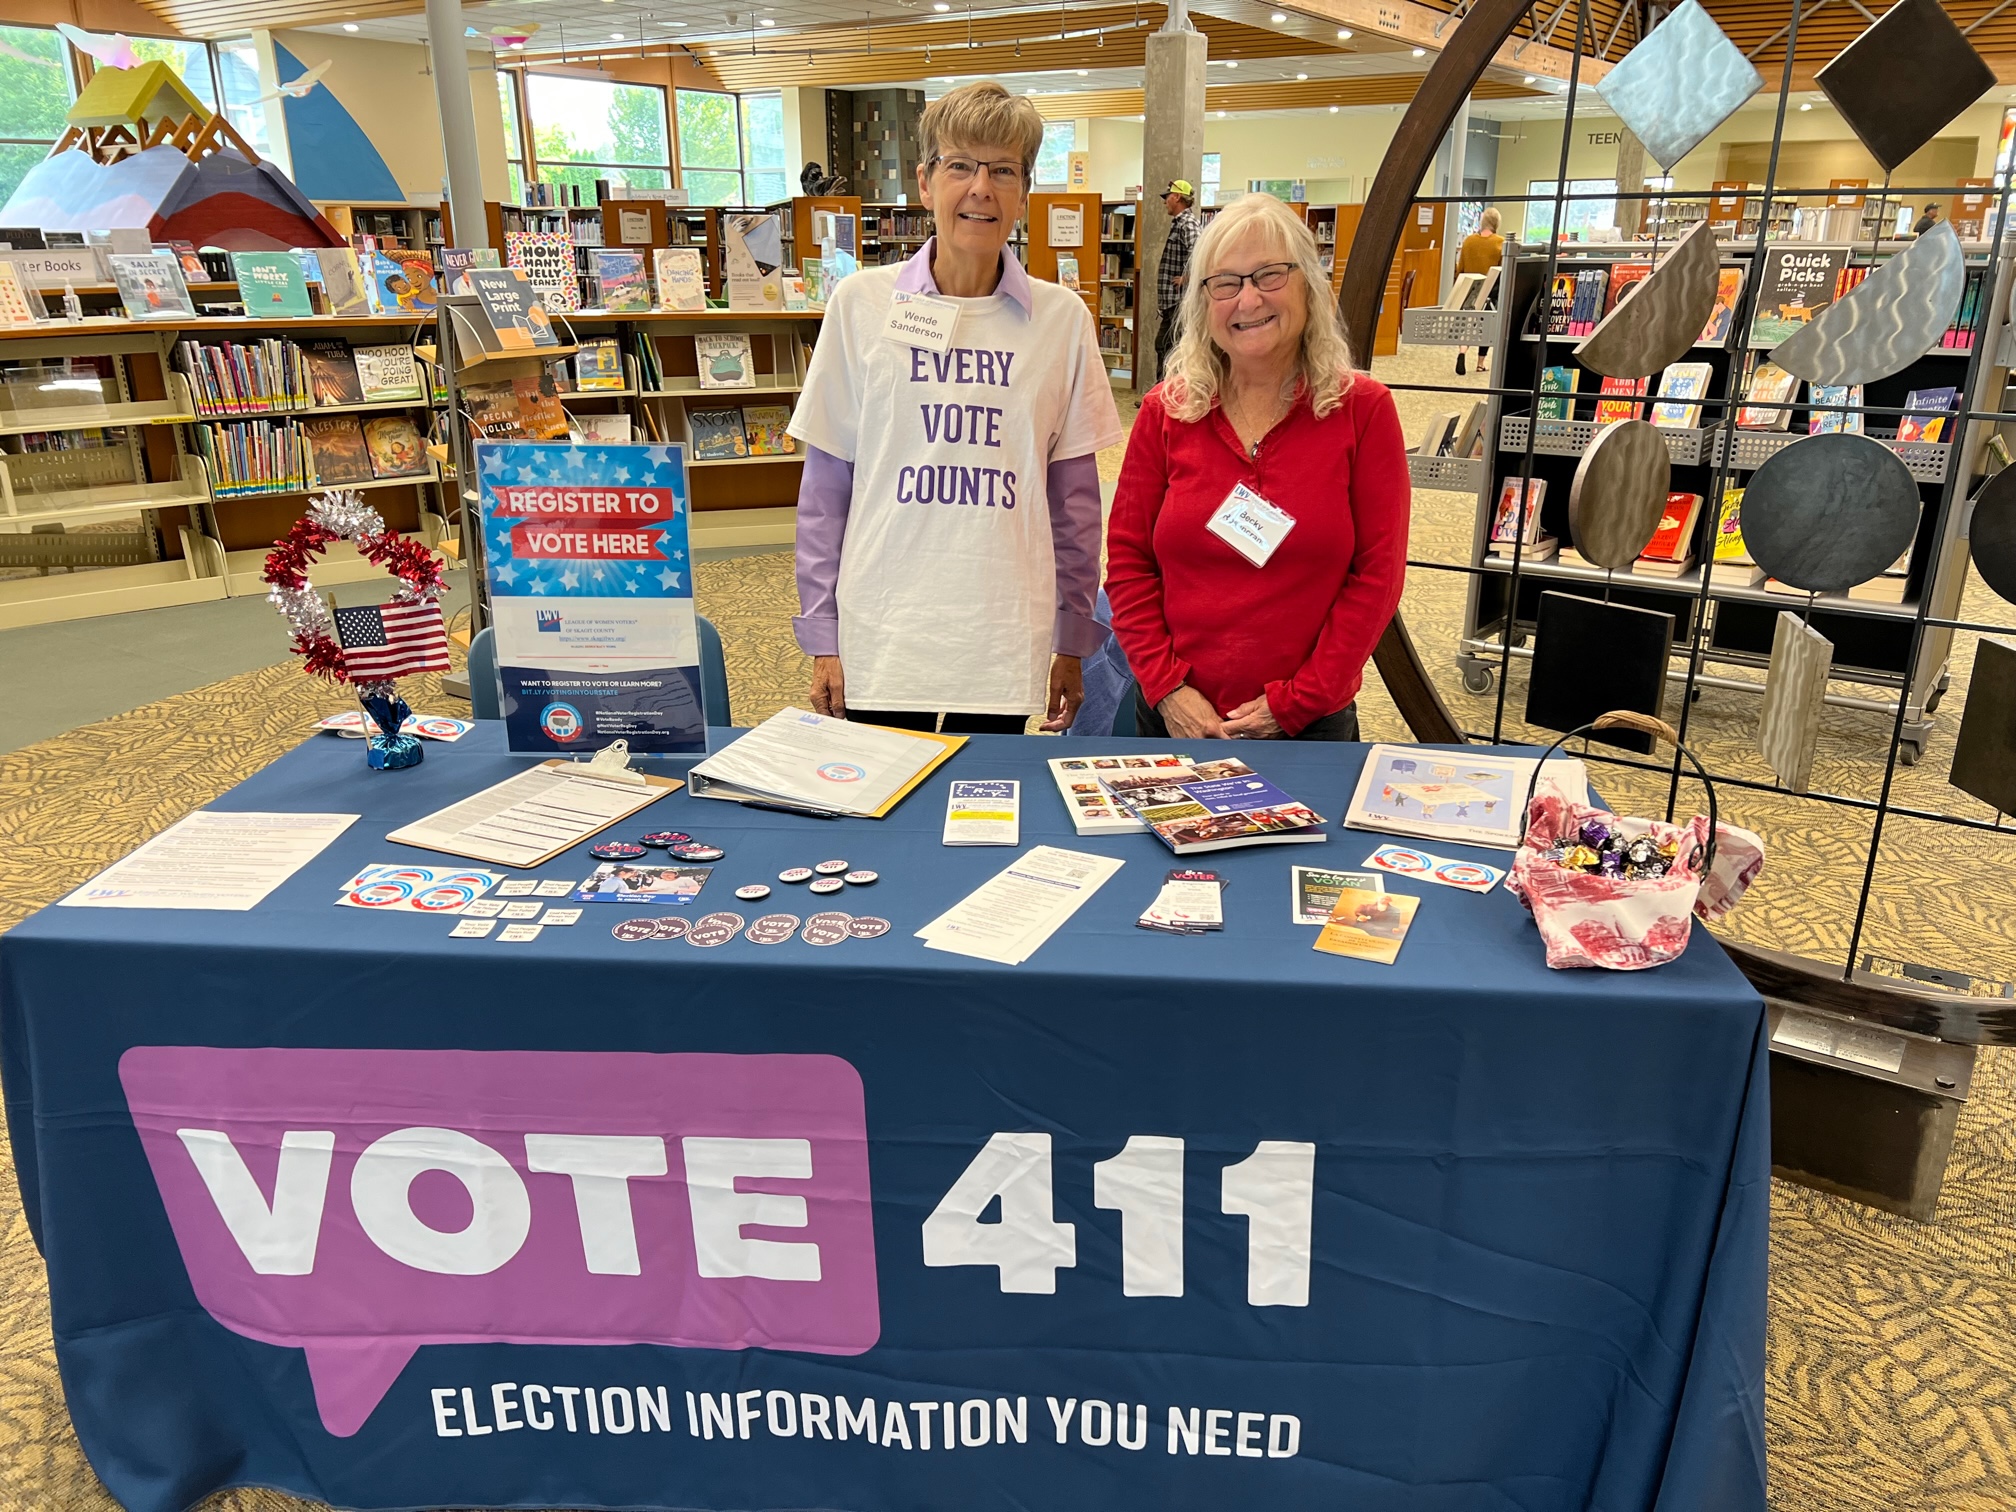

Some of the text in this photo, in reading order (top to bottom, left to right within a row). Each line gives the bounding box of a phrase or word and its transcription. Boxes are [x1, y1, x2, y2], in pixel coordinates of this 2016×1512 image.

[1587, 132, 1621, 144] TEEN
[446, 250, 496, 266] NEVER GIVE UP
[522, 246, 560, 258] HOW
[45, 259, 82, 272] Books
[130, 260, 160, 270] SALAT
[524, 258, 560, 268] MANY
[1780, 253, 1831, 268] Quick
[138, 268, 168, 276] SECRET
[526, 268, 562, 278] JELLY
[666, 268, 694, 276] DANCING
[1780, 268, 1825, 282] Picks
[479, 280, 508, 290] New
[484, 290, 520, 302] Large
[895, 292, 912, 302] LWV
[490, 302, 522, 314] Print
[904, 310, 938, 326] Wende
[890, 320, 942, 340] Sanderson
[358, 346, 408, 358] WOO HOO!
[380, 356, 411, 366] YOU'RE
[910, 347, 1014, 387] EVERY
[383, 366, 412, 376] DOING
[381, 374, 414, 386] GREAT!
[475, 391, 511, 402] SHADOWS
[518, 389, 540, 398] what
[541, 400, 556, 408] the
[483, 410, 514, 422] PECAN
[693, 411, 738, 429] SNOW
[482, 421, 520, 434] HOLLOW
[920, 404, 1002, 448] VOTE
[896, 465, 1016, 510] COUNTS
[1235, 486, 1250, 498] LWV
[509, 492, 660, 514] REGISTER TO
[1240, 511, 1264, 530] Becky
[526, 532, 649, 554] VOTE HERE
[538, 610, 560, 620] LWV
[594, 845, 642, 854] VOTER
[1313, 878, 1360, 886] VOTAN
[624, 925, 652, 934] VOTE
[694, 930, 726, 940] VOTE
[812, 928, 840, 939] VOTE
[177, 1127, 1315, 1306] VOTE 411
[431, 1383, 1300, 1457] ELECTION INFORMATION YOU NEED
